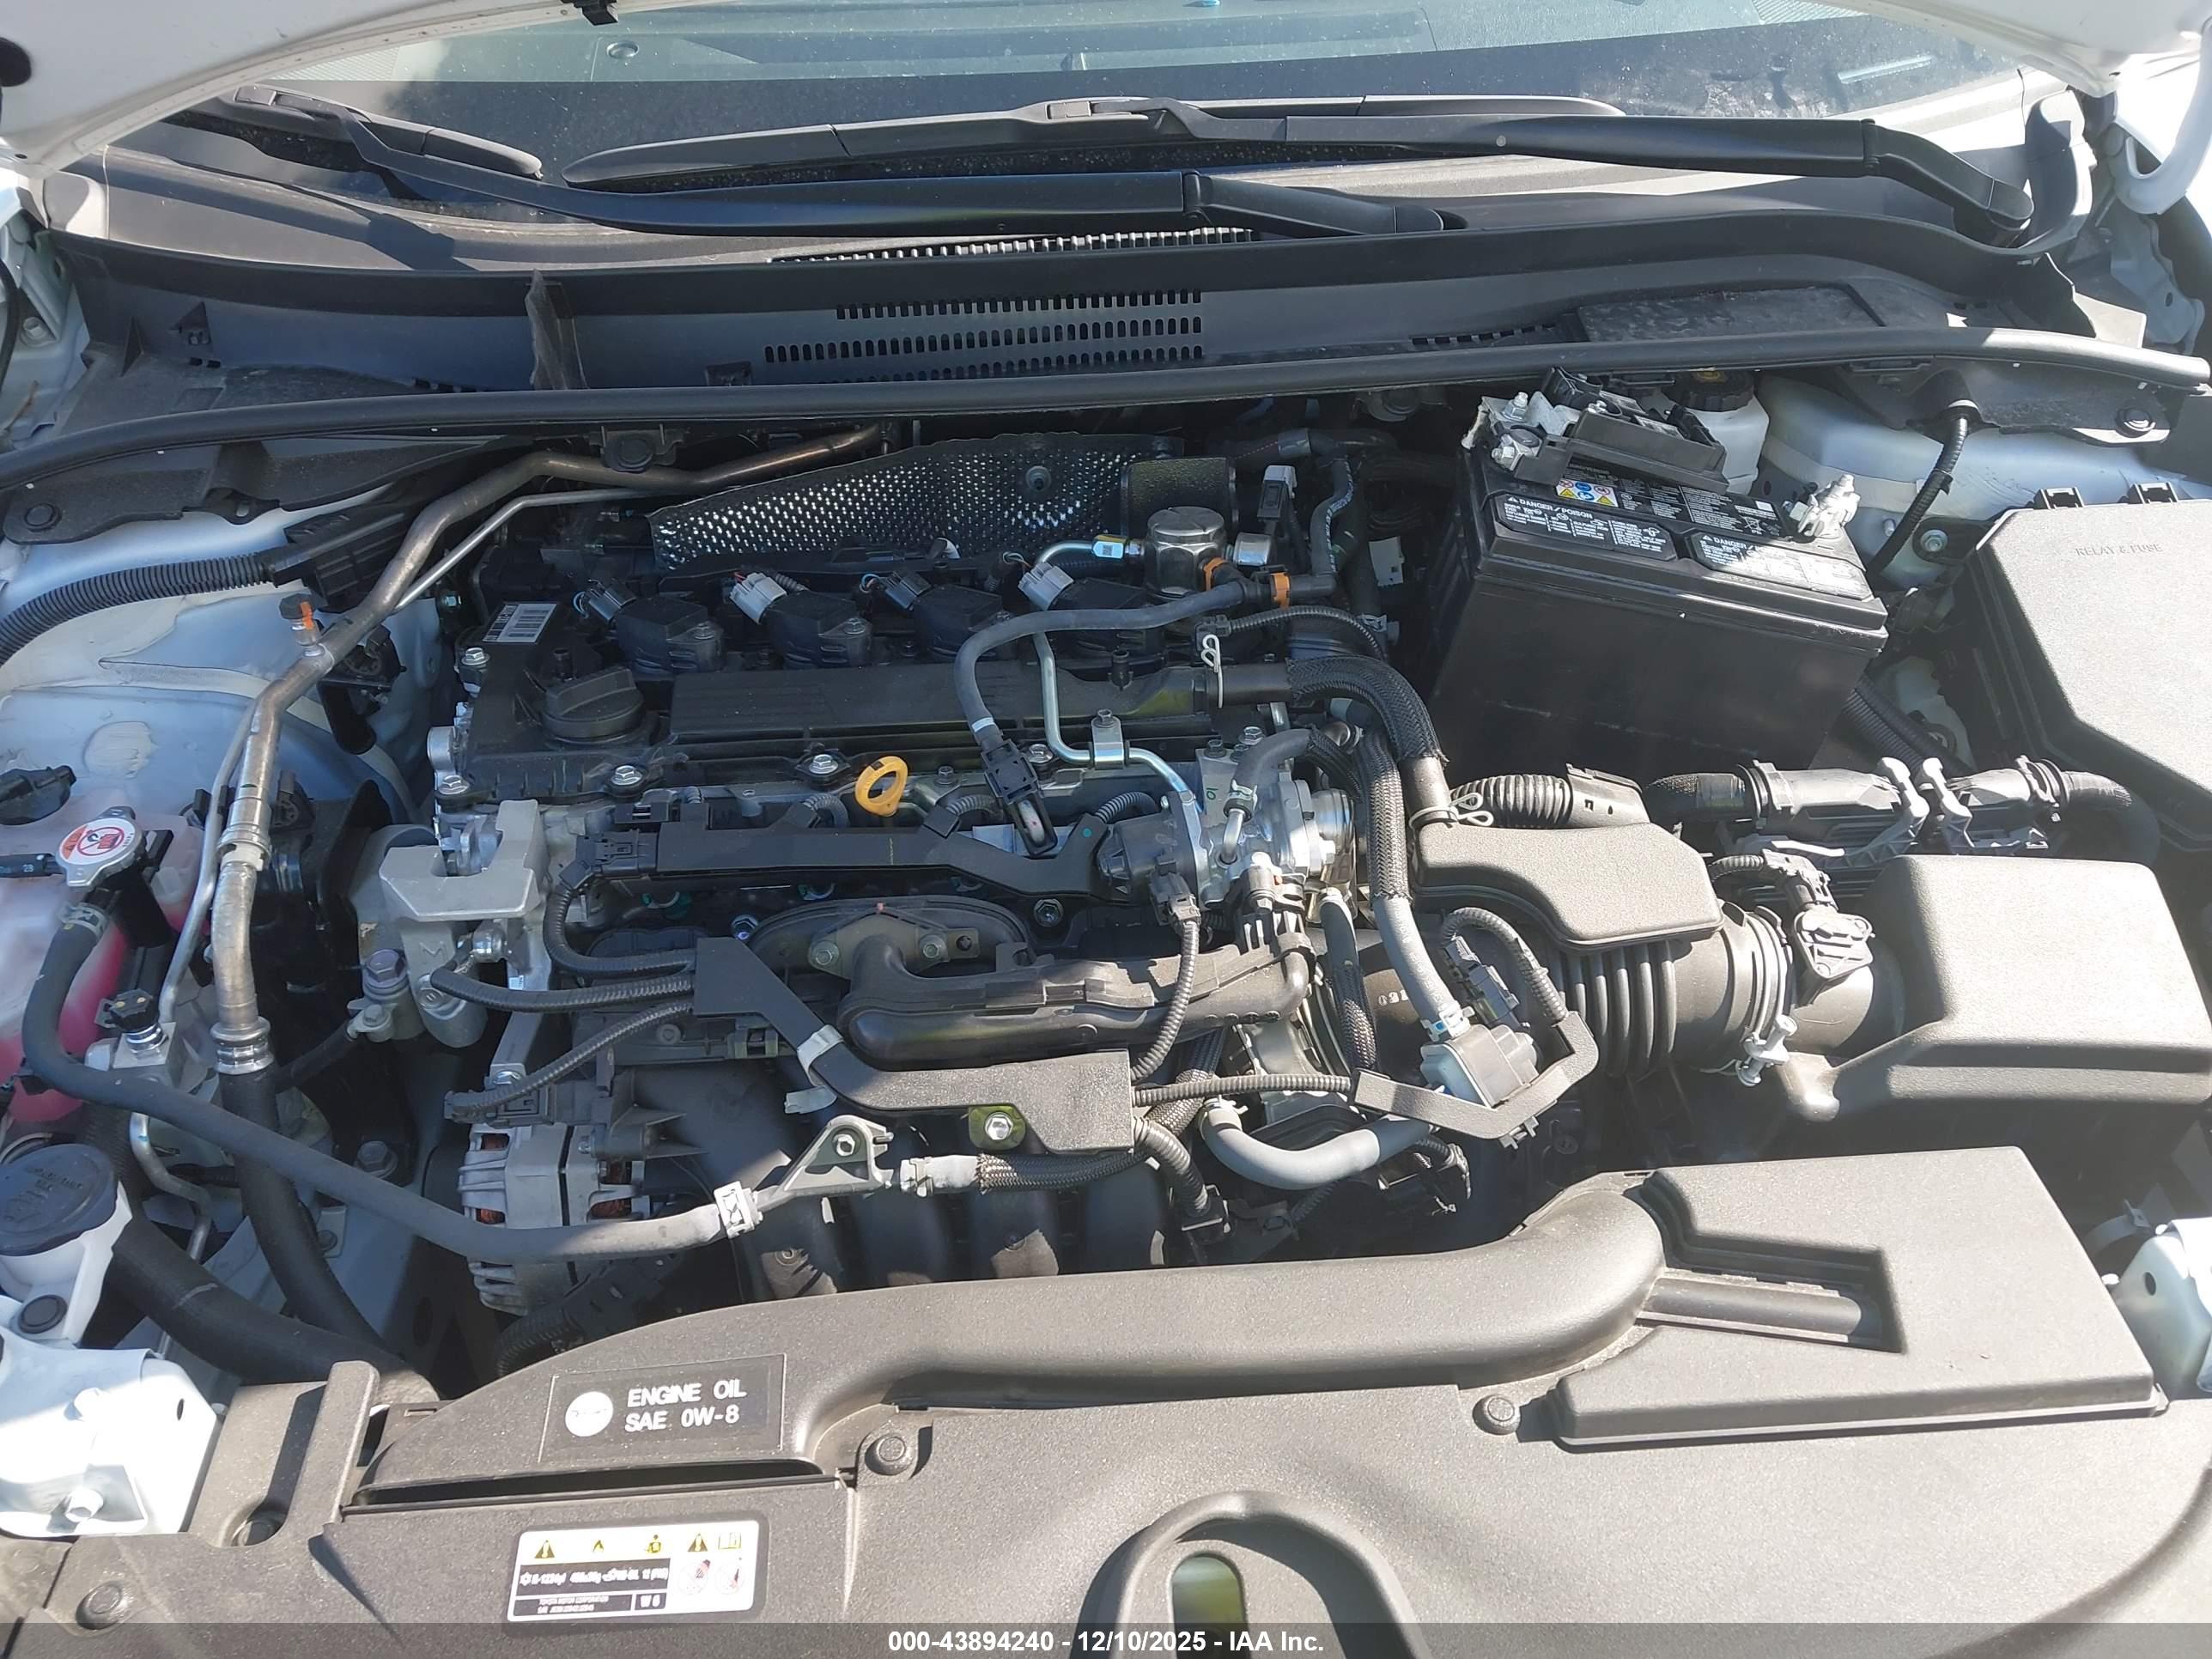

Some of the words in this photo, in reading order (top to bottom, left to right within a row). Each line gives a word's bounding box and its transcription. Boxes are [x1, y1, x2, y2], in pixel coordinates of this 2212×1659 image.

[2075, 546, 2115, 556] RELAY
[2130, 544, 2163, 554] FUSE
[627, 1382, 702, 1407] ENGINE
[713, 1378, 747, 1399] OIL
[624, 1411, 668, 1432] SAE
[681, 1404, 739, 1428] 0W-8
